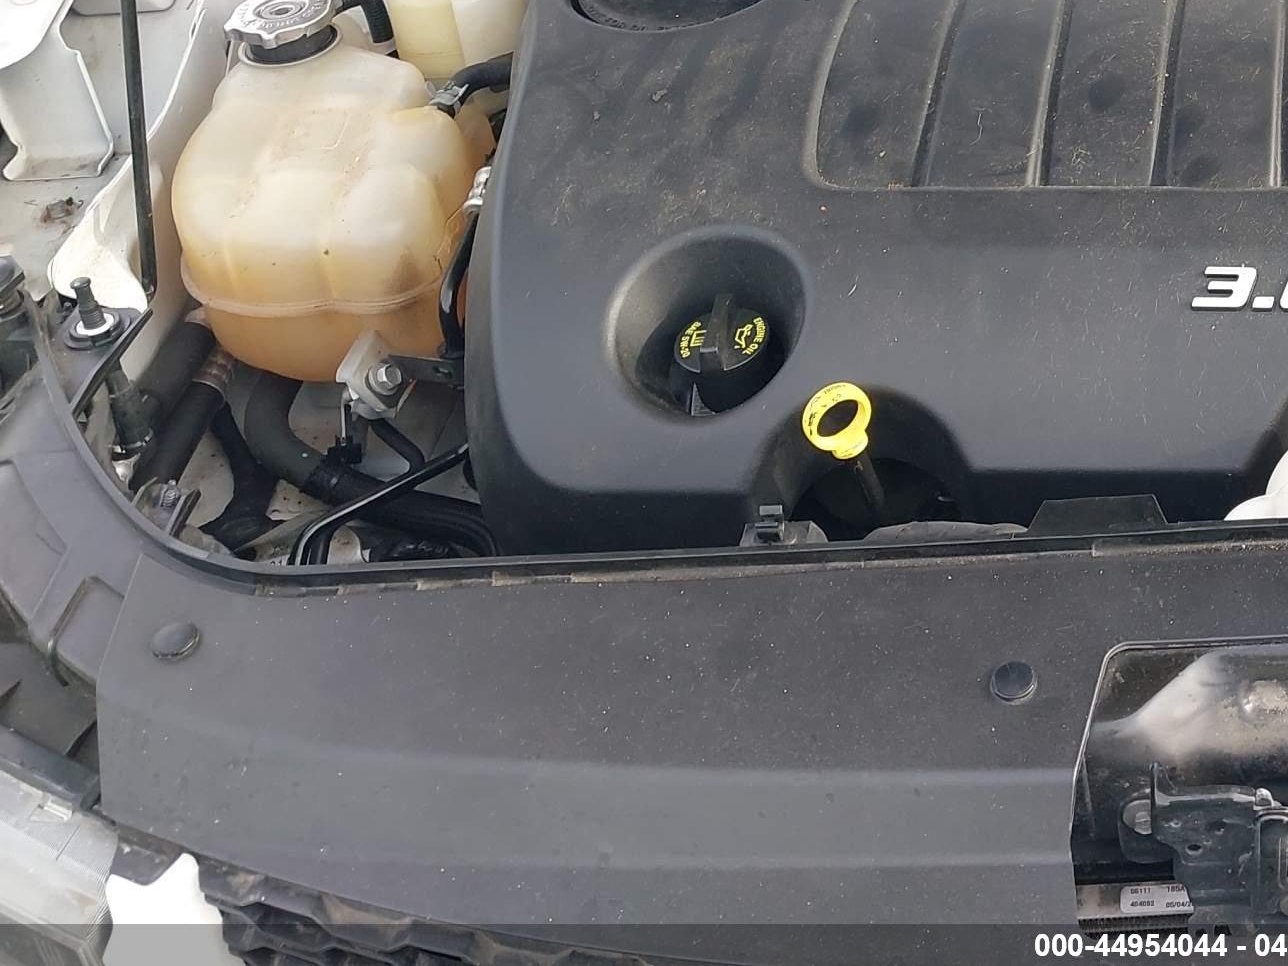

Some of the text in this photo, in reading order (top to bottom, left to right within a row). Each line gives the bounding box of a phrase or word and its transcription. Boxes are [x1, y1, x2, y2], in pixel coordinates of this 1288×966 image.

[680, 321, 701, 357] SAE 5W-20
[742, 317, 765, 355] ENGINE OIL
